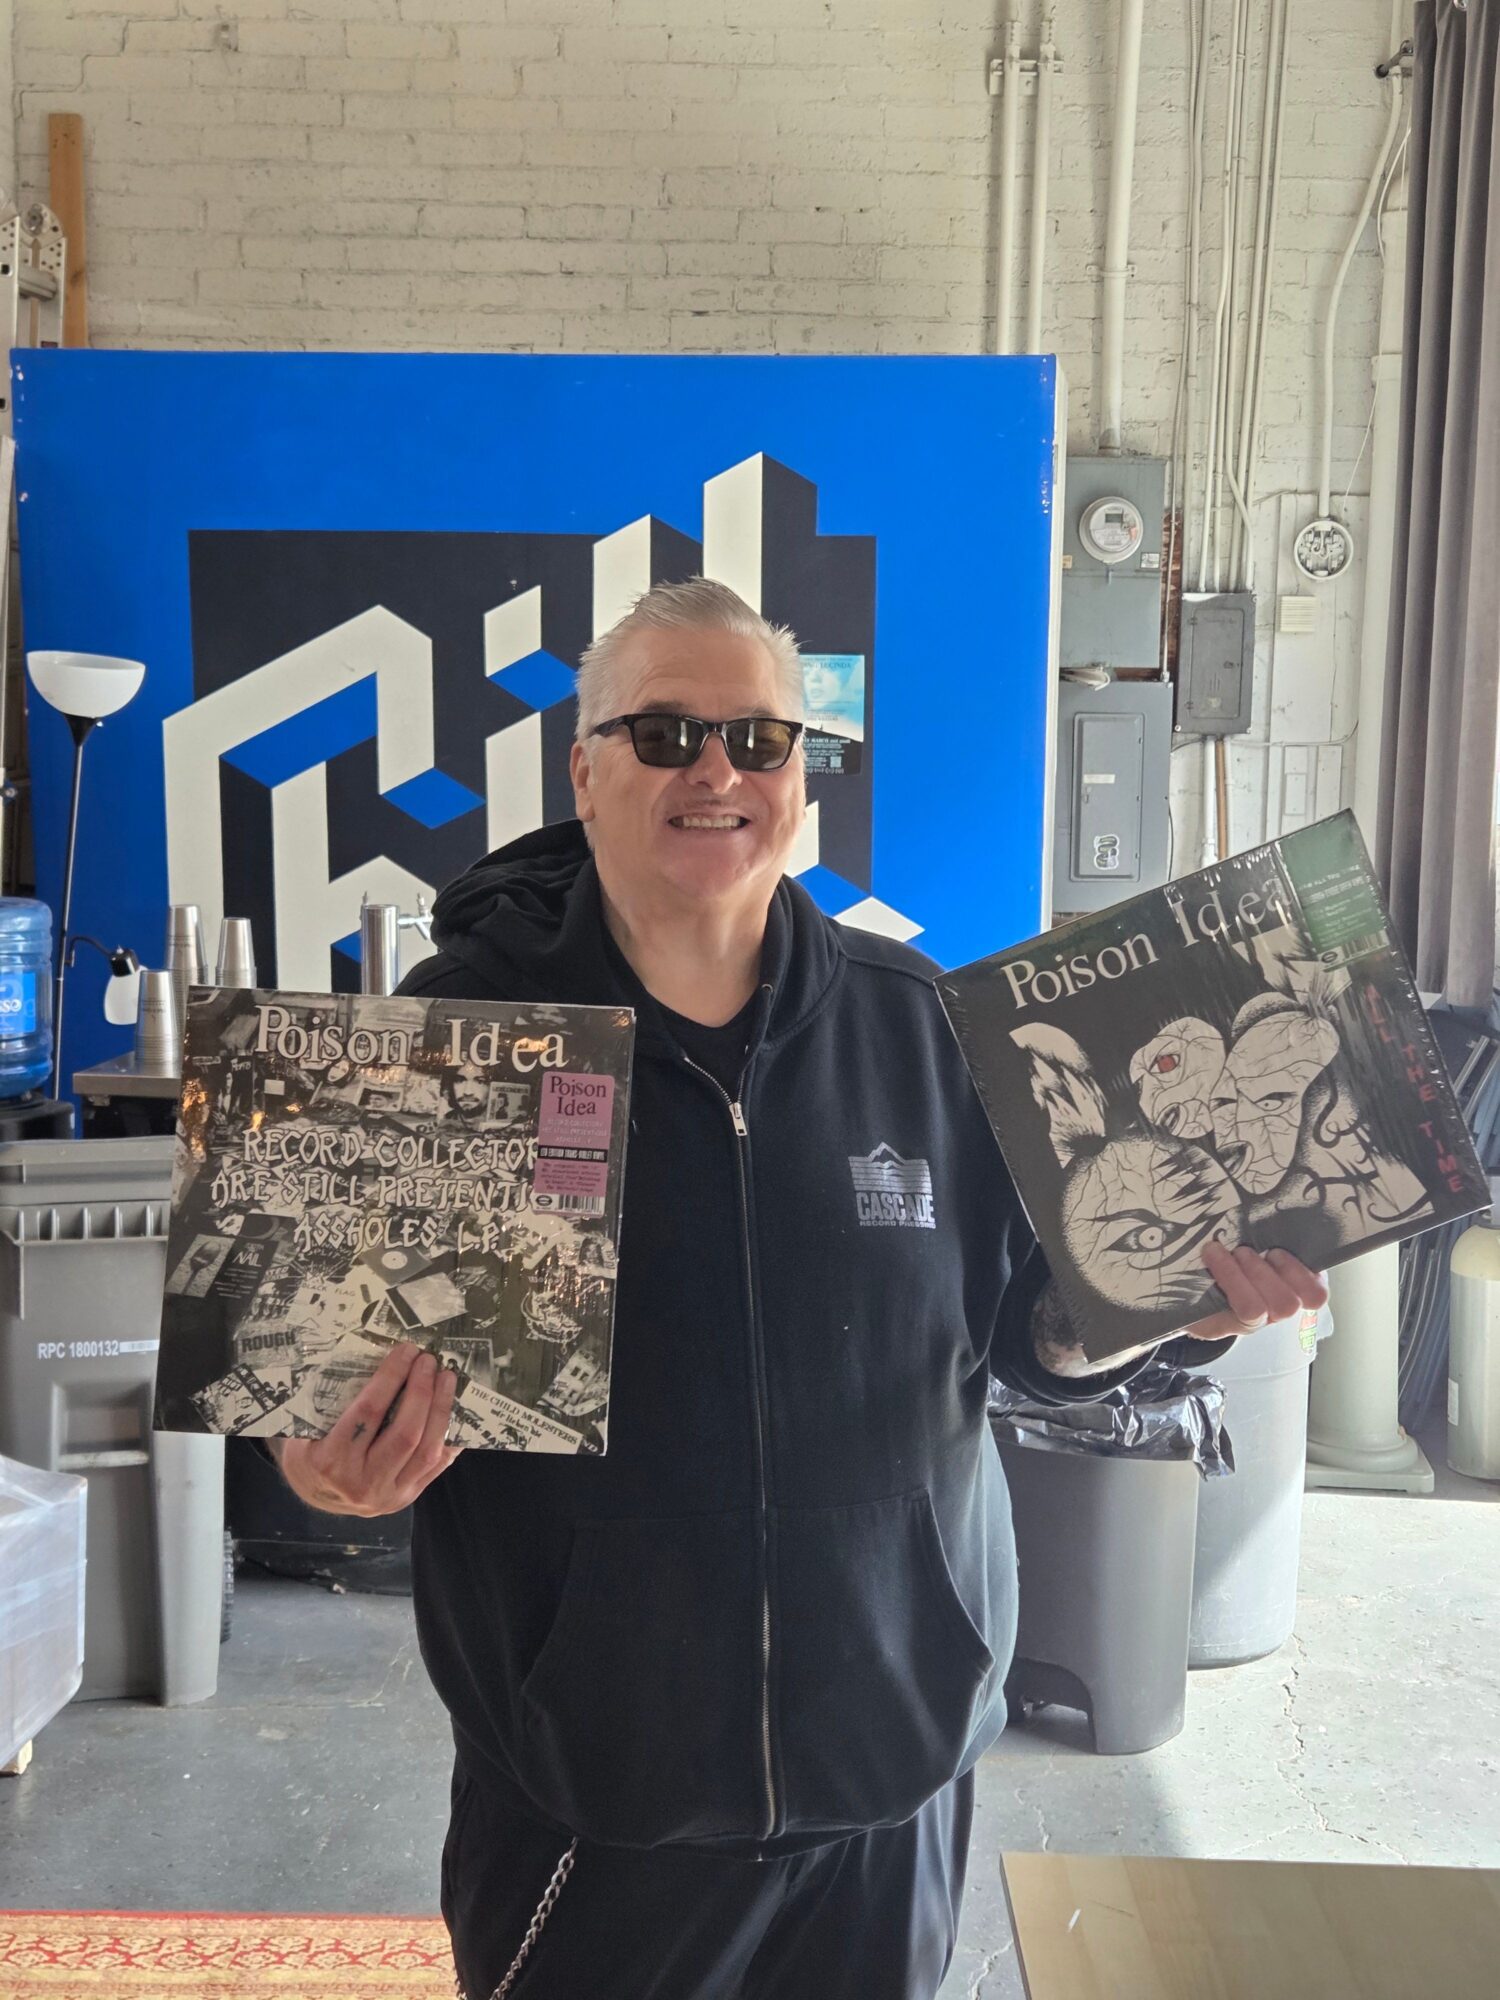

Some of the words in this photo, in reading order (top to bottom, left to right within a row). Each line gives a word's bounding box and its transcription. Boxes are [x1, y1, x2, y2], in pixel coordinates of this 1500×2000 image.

[1000, 932, 1160, 1010] Poison
[1170, 878, 1294, 949] Idea
[1365, 983, 1396, 1044] ALL
[254, 1004, 411, 1067] Poison
[445, 1018, 570, 1073] Idea
[550, 1075, 607, 1098] Poison
[1402, 1043, 1437, 1104] THE
[556, 1096, 597, 1117] Idea
[242, 1128, 363, 1167] RECORD
[1418, 1121, 1465, 1194] TIME
[210, 1169, 271, 1209] ARE
[281, 1172, 365, 1206] STILL
[377, 1174, 534, 1213] PRETENTI
[855, 1191, 936, 1223] CASCADE
[293, 1211, 438, 1253] ASSHOLES
[456, 1221, 500, 1255] L.P.
[898, 1220, 937, 1230] PRESSING
[38, 1342, 65, 1359] RPC
[69, 1340, 119, 1358] 1800132
[240, 1331, 297, 1353] ROUGH
[470, 1386, 489, 1401] THE
[490, 1397, 521, 1416] CHILD
[522, 1412, 578, 1445] MOLESTERS
